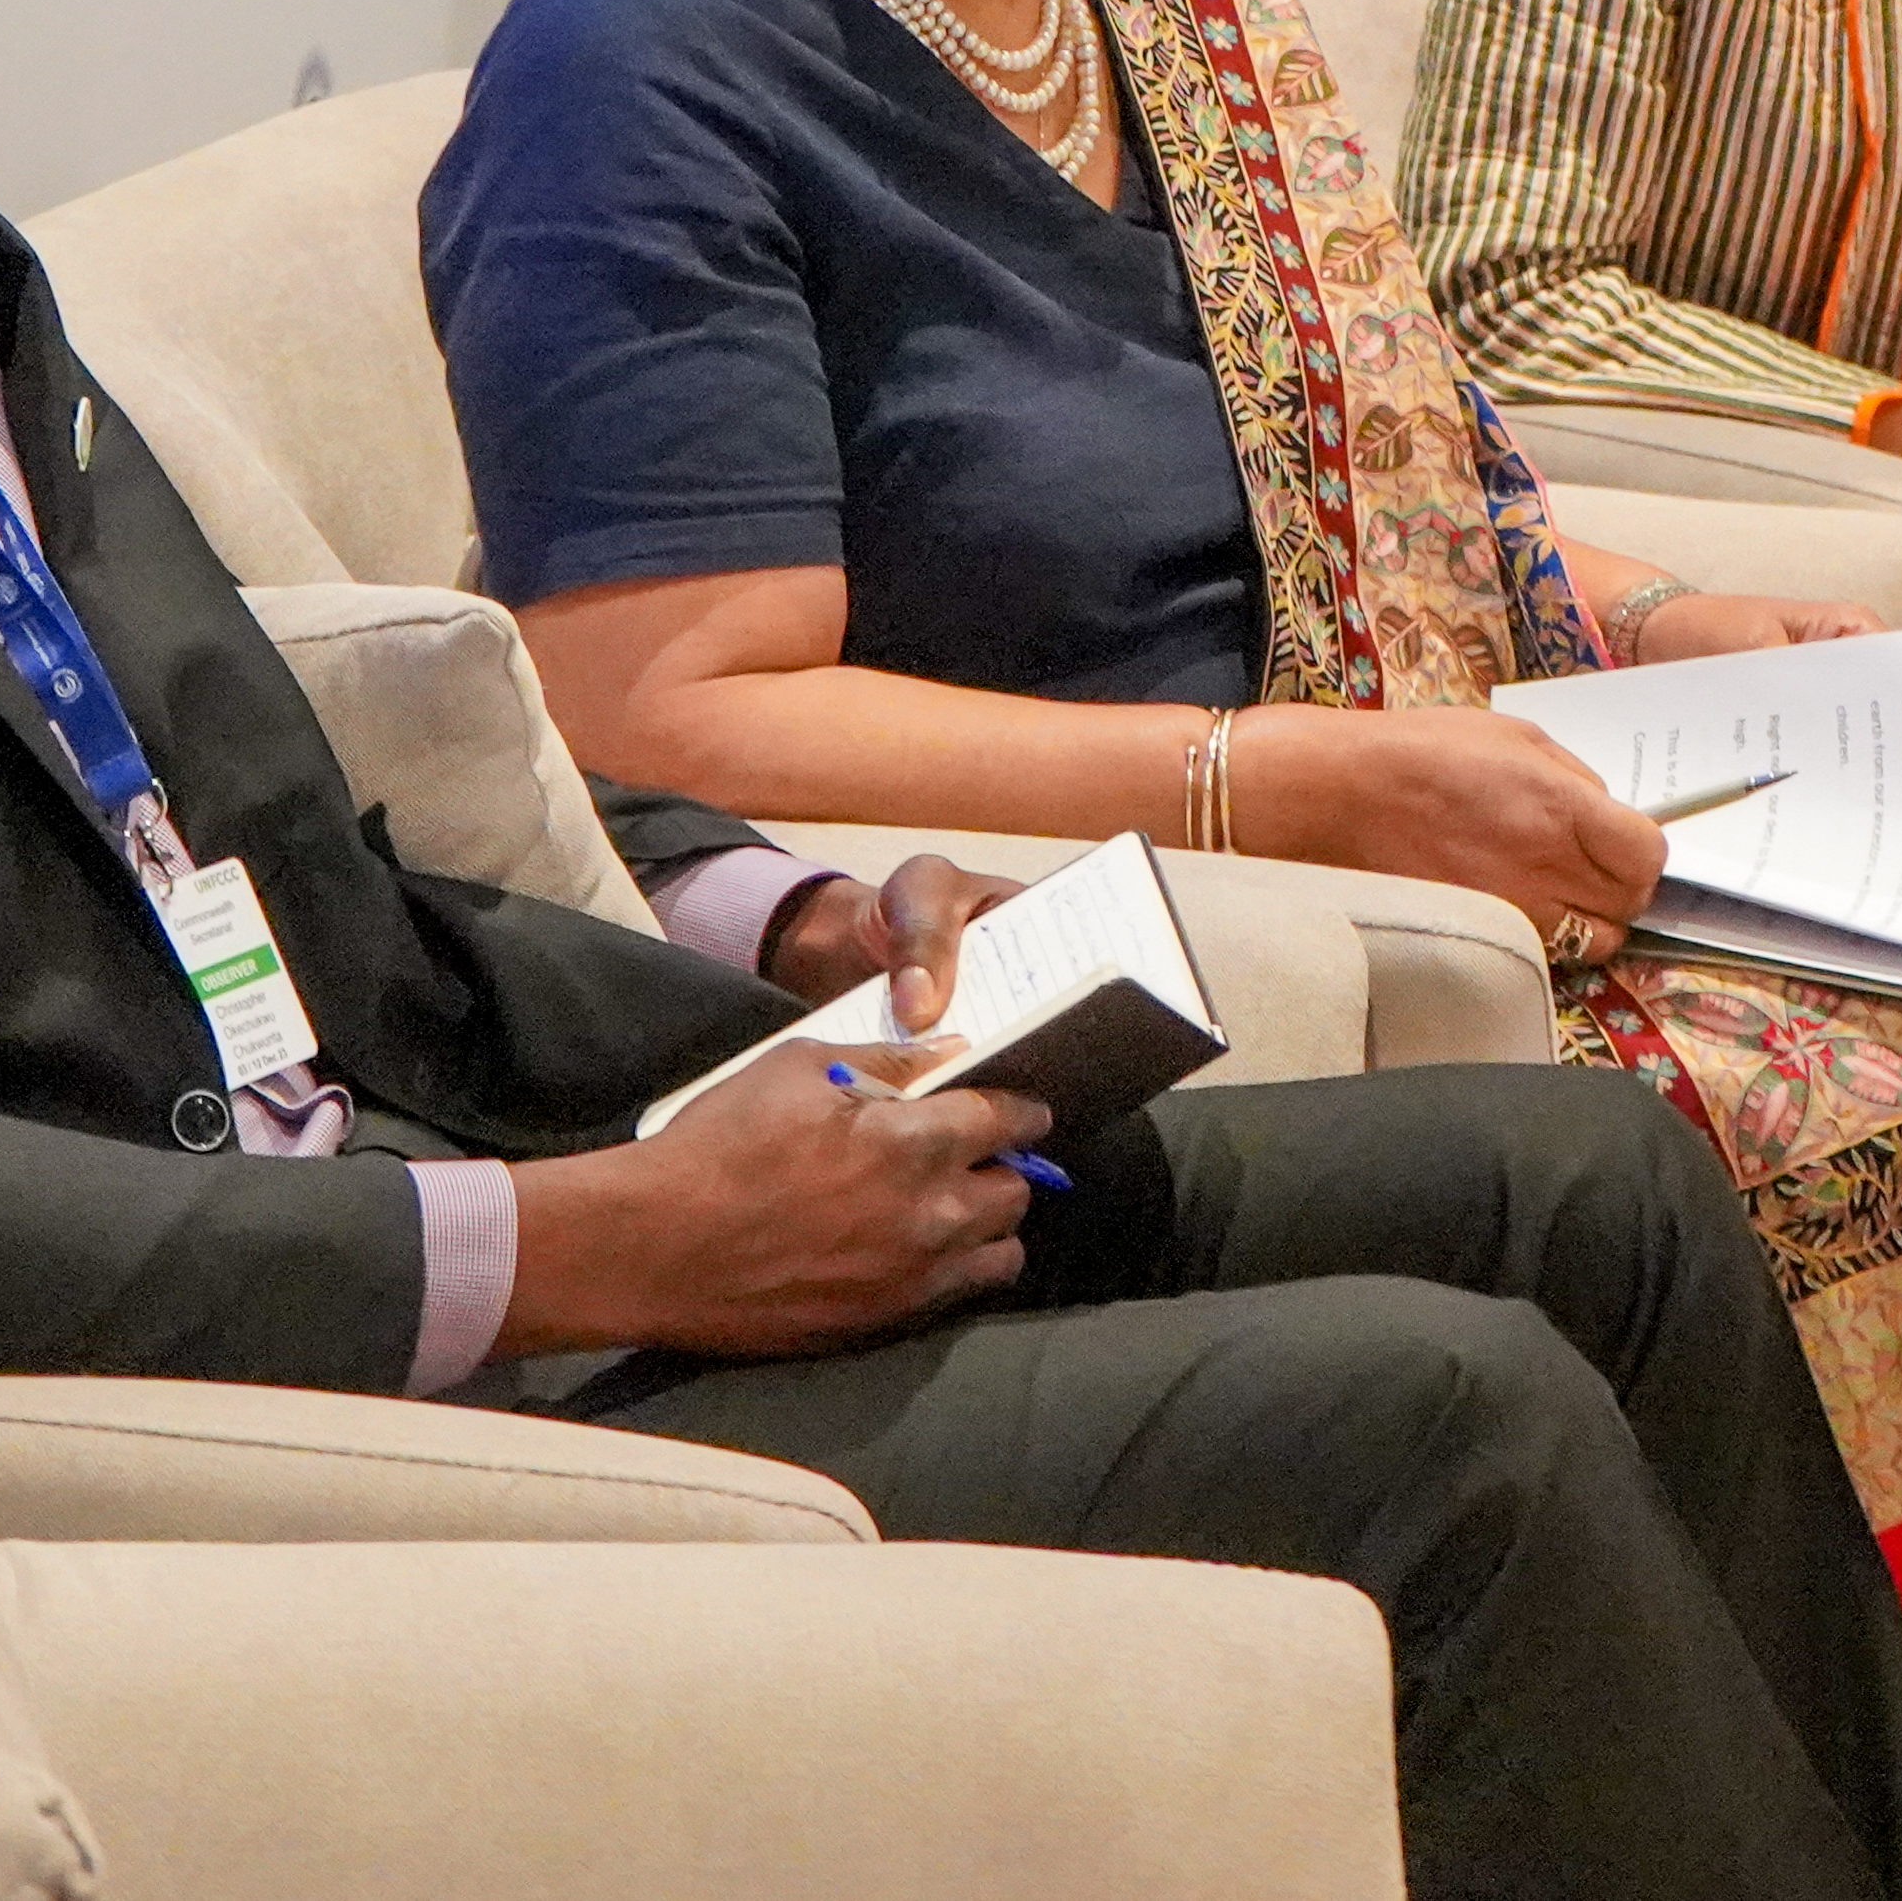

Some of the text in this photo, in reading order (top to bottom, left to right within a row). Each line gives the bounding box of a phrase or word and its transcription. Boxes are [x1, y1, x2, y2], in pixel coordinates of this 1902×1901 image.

[1869, 700, 1885, 740] earth
[1873, 744, 1887, 779] from
[194, 866, 241, 895] UNFCCC
[200, 958, 259, 993] OBSERVER
